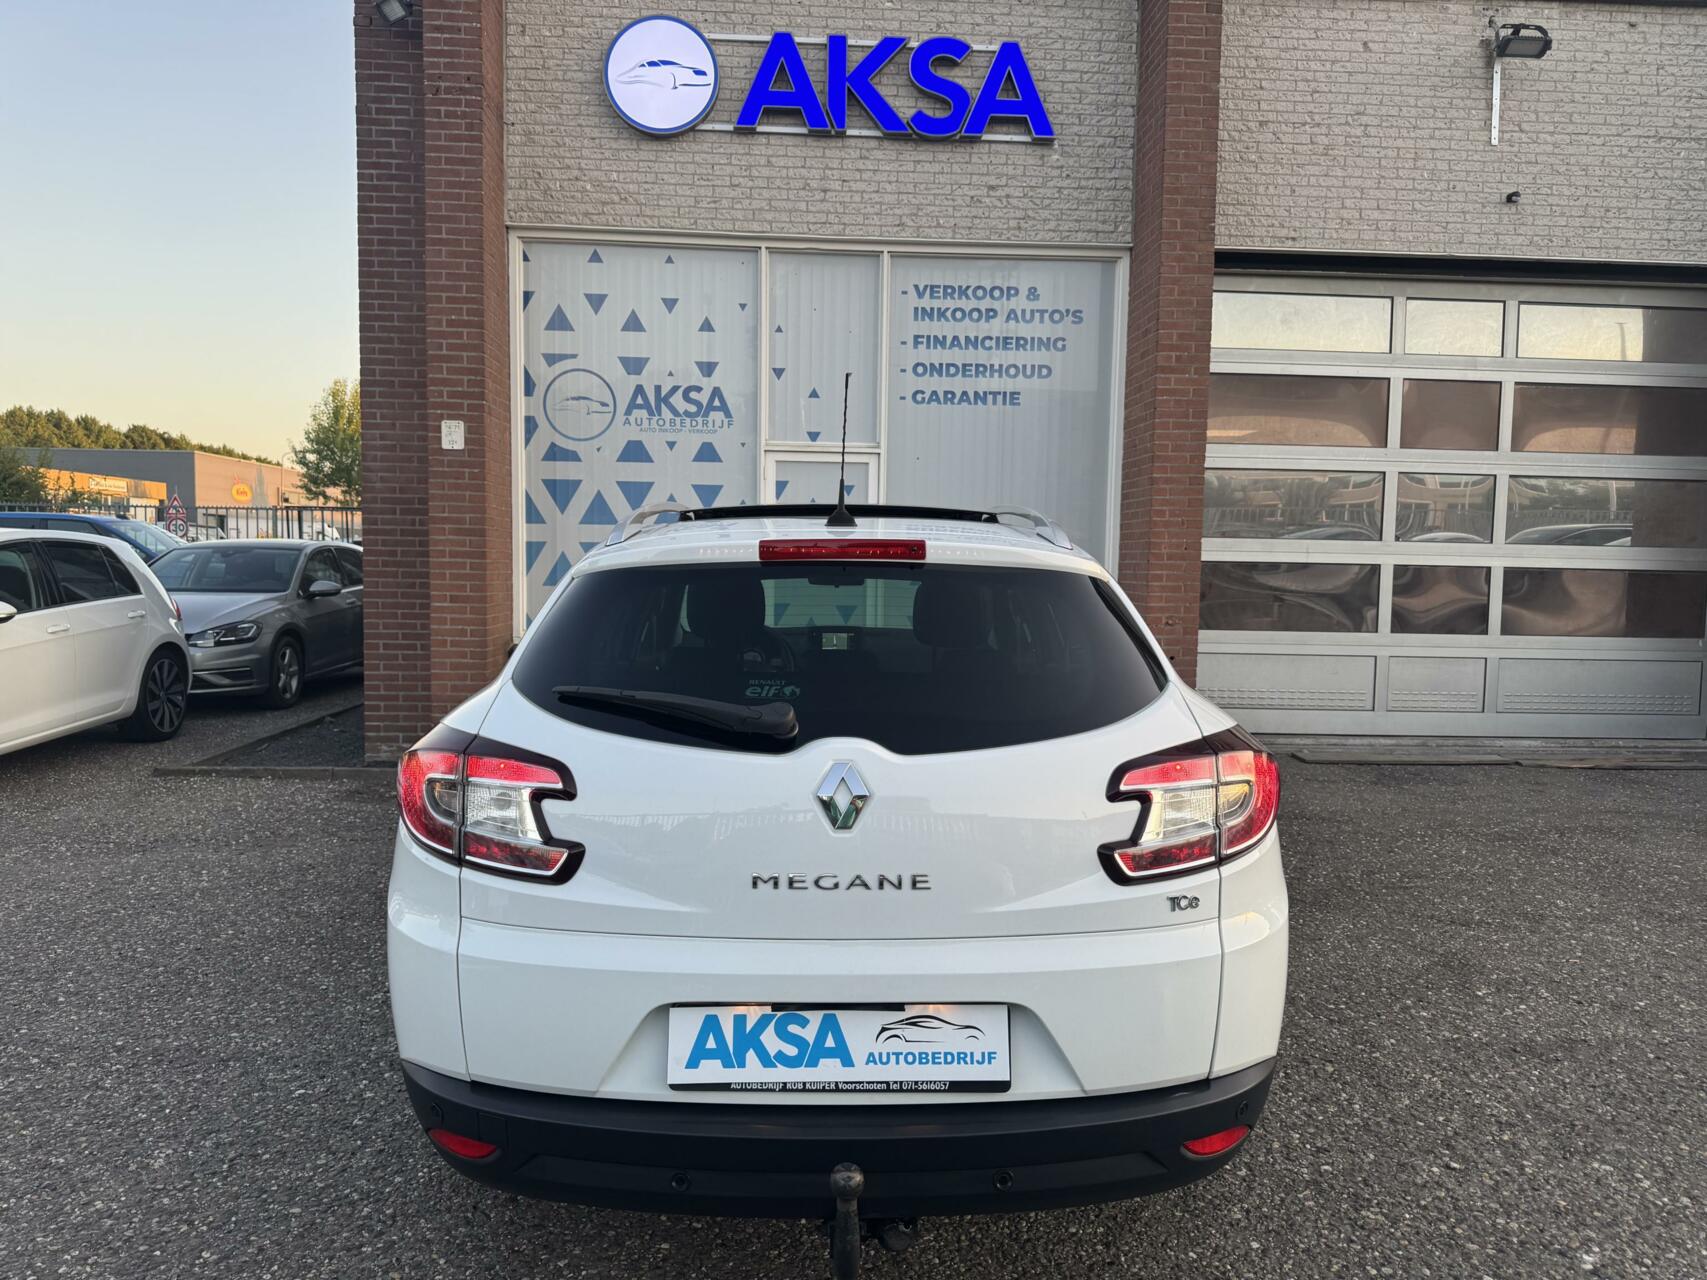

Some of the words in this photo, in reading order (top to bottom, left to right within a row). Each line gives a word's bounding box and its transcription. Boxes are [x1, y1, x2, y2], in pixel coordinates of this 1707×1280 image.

[734, 31, 1056, 142] AKSA
[913, 284, 1020, 301] VERKOOP
[1026, 286, 1041, 302] &
[913, 306, 999, 323] INKOOP
[1004, 308, 1084, 325] AUTO'S
[912, 334, 1067, 352] FINANCIERING
[911, 361, 1053, 379] ONDERHOUD
[623, 384, 734, 419] AKSA
[911, 389, 1021, 406] GARANTIE
[623, 417, 735, 429] AUTOBEDRIJF
[171, 523, 185, 533] 30
[751, 873, 932, 890] MEGANE
[1166, 895, 1201, 912] TCe
[684, 1012, 856, 1070] AKSA
[865, 1051, 998, 1066] AUTOBEDRIJF
[730, 1081, 785, 1091] AUTOBEDRIJF
[786, 1081, 804, 1090] ROB
[805, 1081, 836, 1090] KUIPER
[838, 1081, 887, 1090] Voorschoten
[889, 1081, 900, 1090] Tel
[902, 1081, 950, 1091] 071-5616057
